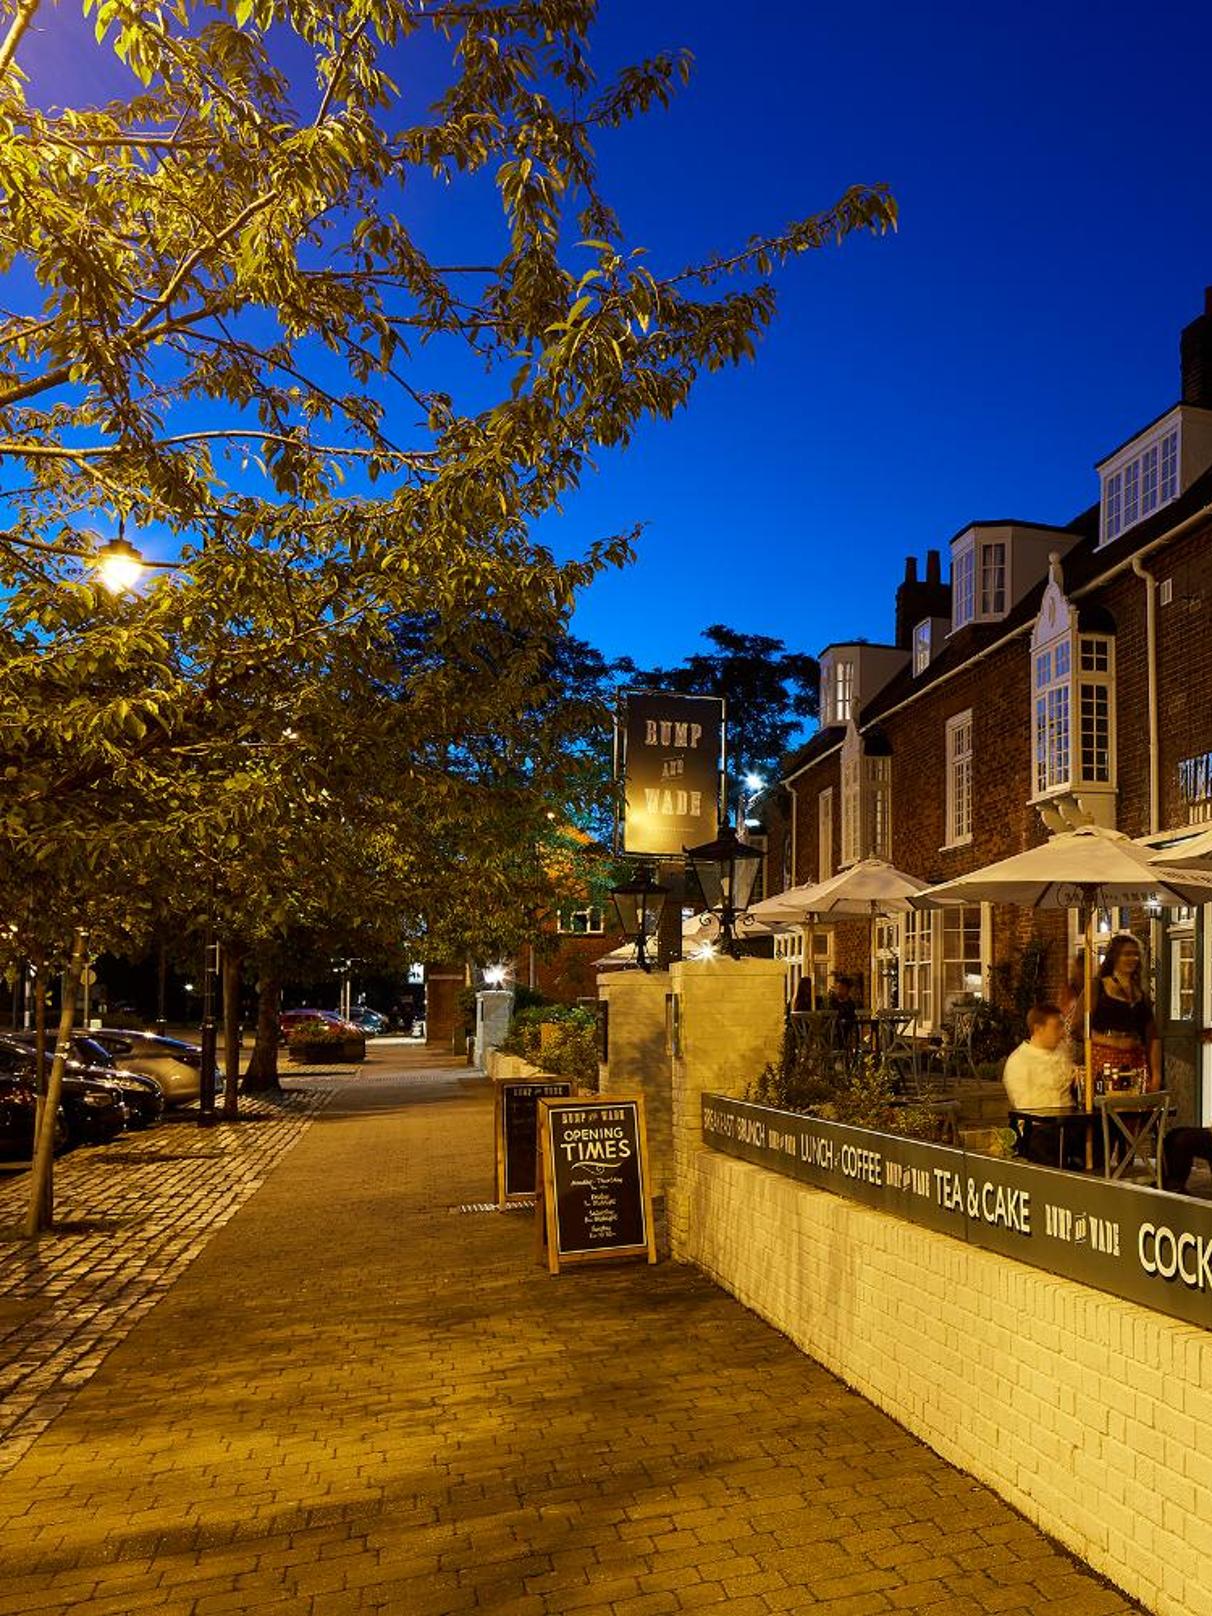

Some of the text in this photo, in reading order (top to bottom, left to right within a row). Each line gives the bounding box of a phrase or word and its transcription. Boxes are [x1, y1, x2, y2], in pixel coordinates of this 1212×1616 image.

[644, 720, 703, 748] RUMP
[661, 759, 684, 777] AND
[644, 788, 702, 817] WADE
[564, 1127, 623, 1141] OPENING
[560, 1140, 631, 1161] TIMES
[800, 1133, 833, 1170] LUNCH
[841, 1144, 882, 1186] COFFEE
[934, 1167, 963, 1212] TEA
[982, 1182, 1031, 1234] CAKE
[1044, 1203, 1073, 1242] RUMP
[1088, 1215, 1120, 1257] WADE
